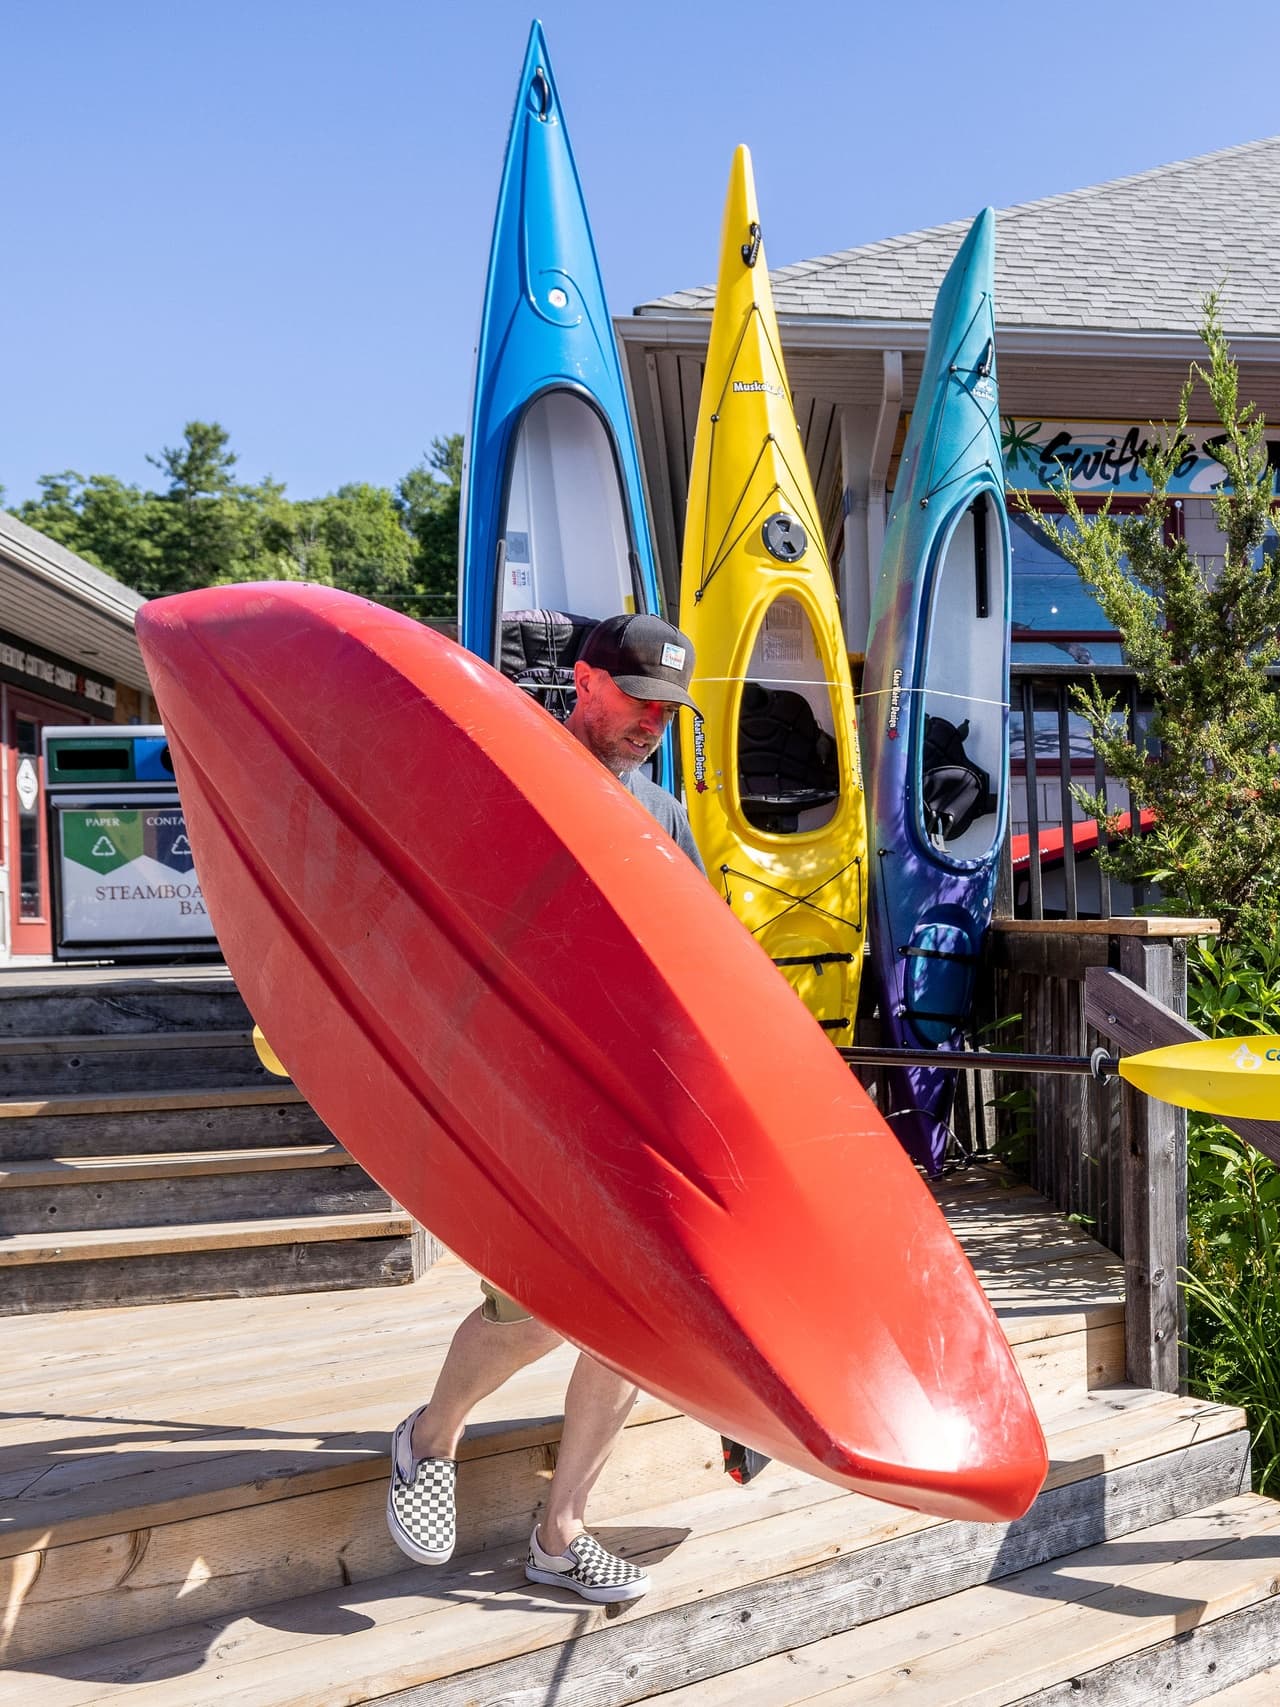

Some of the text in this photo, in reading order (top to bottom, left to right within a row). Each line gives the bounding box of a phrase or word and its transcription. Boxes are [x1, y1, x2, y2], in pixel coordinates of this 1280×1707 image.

[889, 706, 901, 728] Design
[695, 756, 706, 780] Design
[85, 816, 120, 827] PAPER
